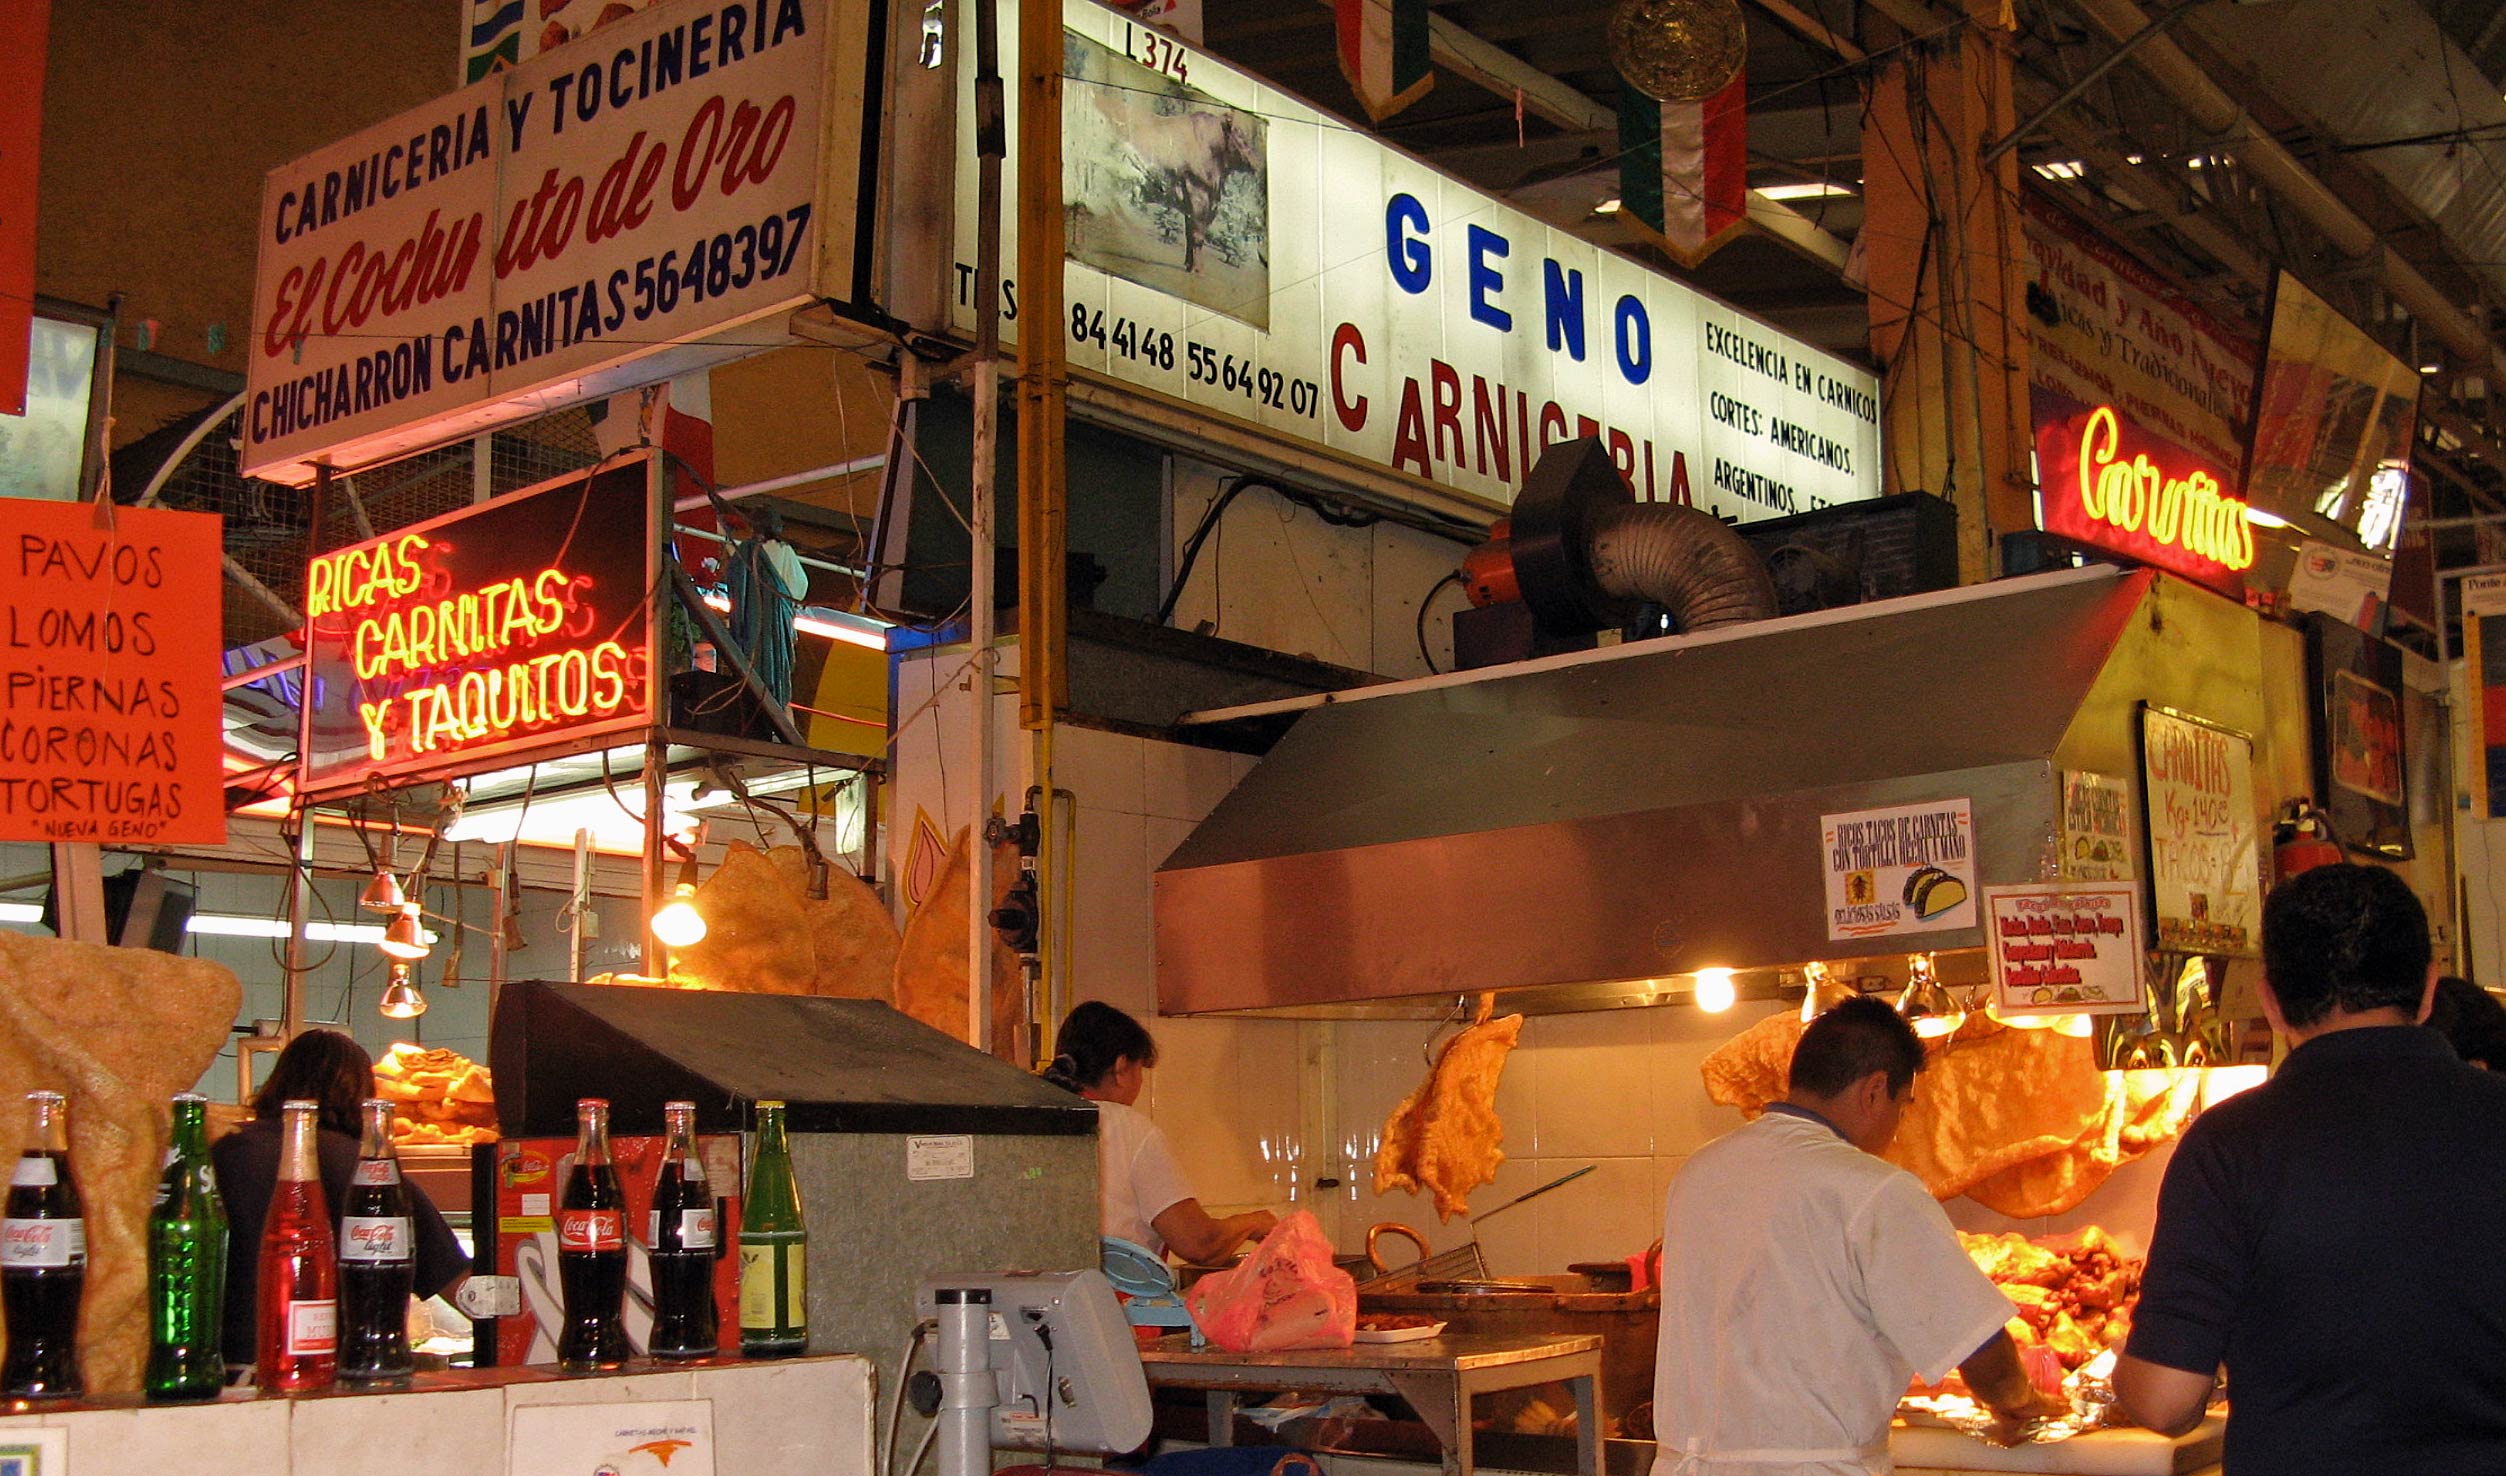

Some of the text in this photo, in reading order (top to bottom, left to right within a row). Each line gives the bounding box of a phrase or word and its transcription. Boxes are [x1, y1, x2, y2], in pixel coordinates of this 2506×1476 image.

[276, 0, 806, 244] CARNICERIA Y TOCINERIA
[264, 256, 327, 358] El
[587, 130, 667, 244] de
[672, 94, 796, 213] Oro
[252, 202, 812, 444] CHICHARRON CARNITAS 5648397
[1386, 193, 1652, 386] GENO
[1705, 320, 1878, 425] EXCELENCIA EN CARNICOS
[1710, 390, 1764, 436] CORTES:
[1330, 322, 1693, 508] CARNIRIA
[20, 534, 162, 589] PAVOS
[308, 534, 429, 617] RICAS
[9, 605, 156, 657] LOMOS
[356, 568, 569, 680] CARNITAS
[360, 698, 392, 761] Y
[404, 641, 626, 753] TAQUITOS
[0, 717, 178, 772] CORONAS
[2149, 724, 2232, 798] CARNITAS
[0, 776, 182, 820] TORTUGAS
[1836, 811, 1958, 849] RICOS TACOS DE CARNITAS
[1852, 839, 1897, 871] TORTILLA
[1941, 834, 1966, 860] MANO
